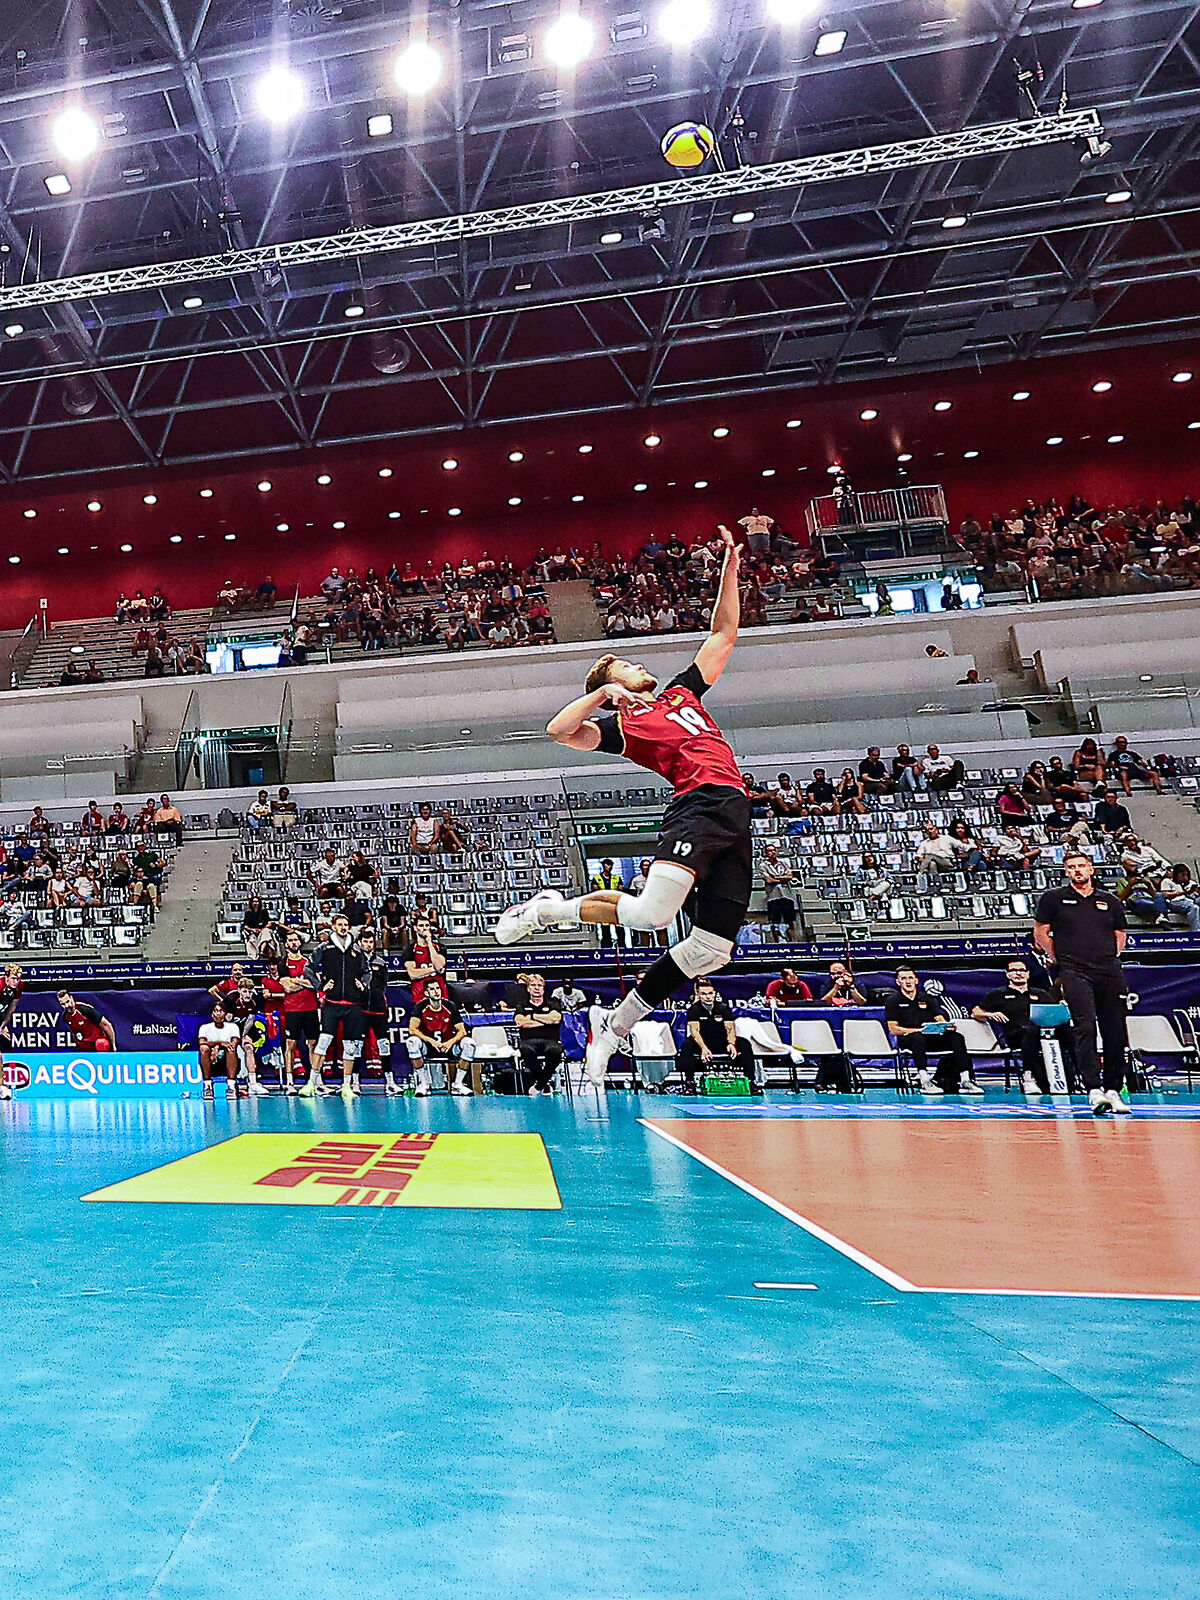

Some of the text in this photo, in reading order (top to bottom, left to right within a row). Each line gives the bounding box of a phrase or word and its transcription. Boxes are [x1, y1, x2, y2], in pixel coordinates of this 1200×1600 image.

[665, 705, 717, 736] 19
[672, 841, 692, 857] 19
[11, 1012, 60, 1028] FIPAV
[133, 1023, 177, 1035] #LaNazio
[433, 1030, 442, 1043] 5
[11, 1031, 77, 1048] MEN EL
[34, 1058, 202, 1095] AEQUILIBRIU
